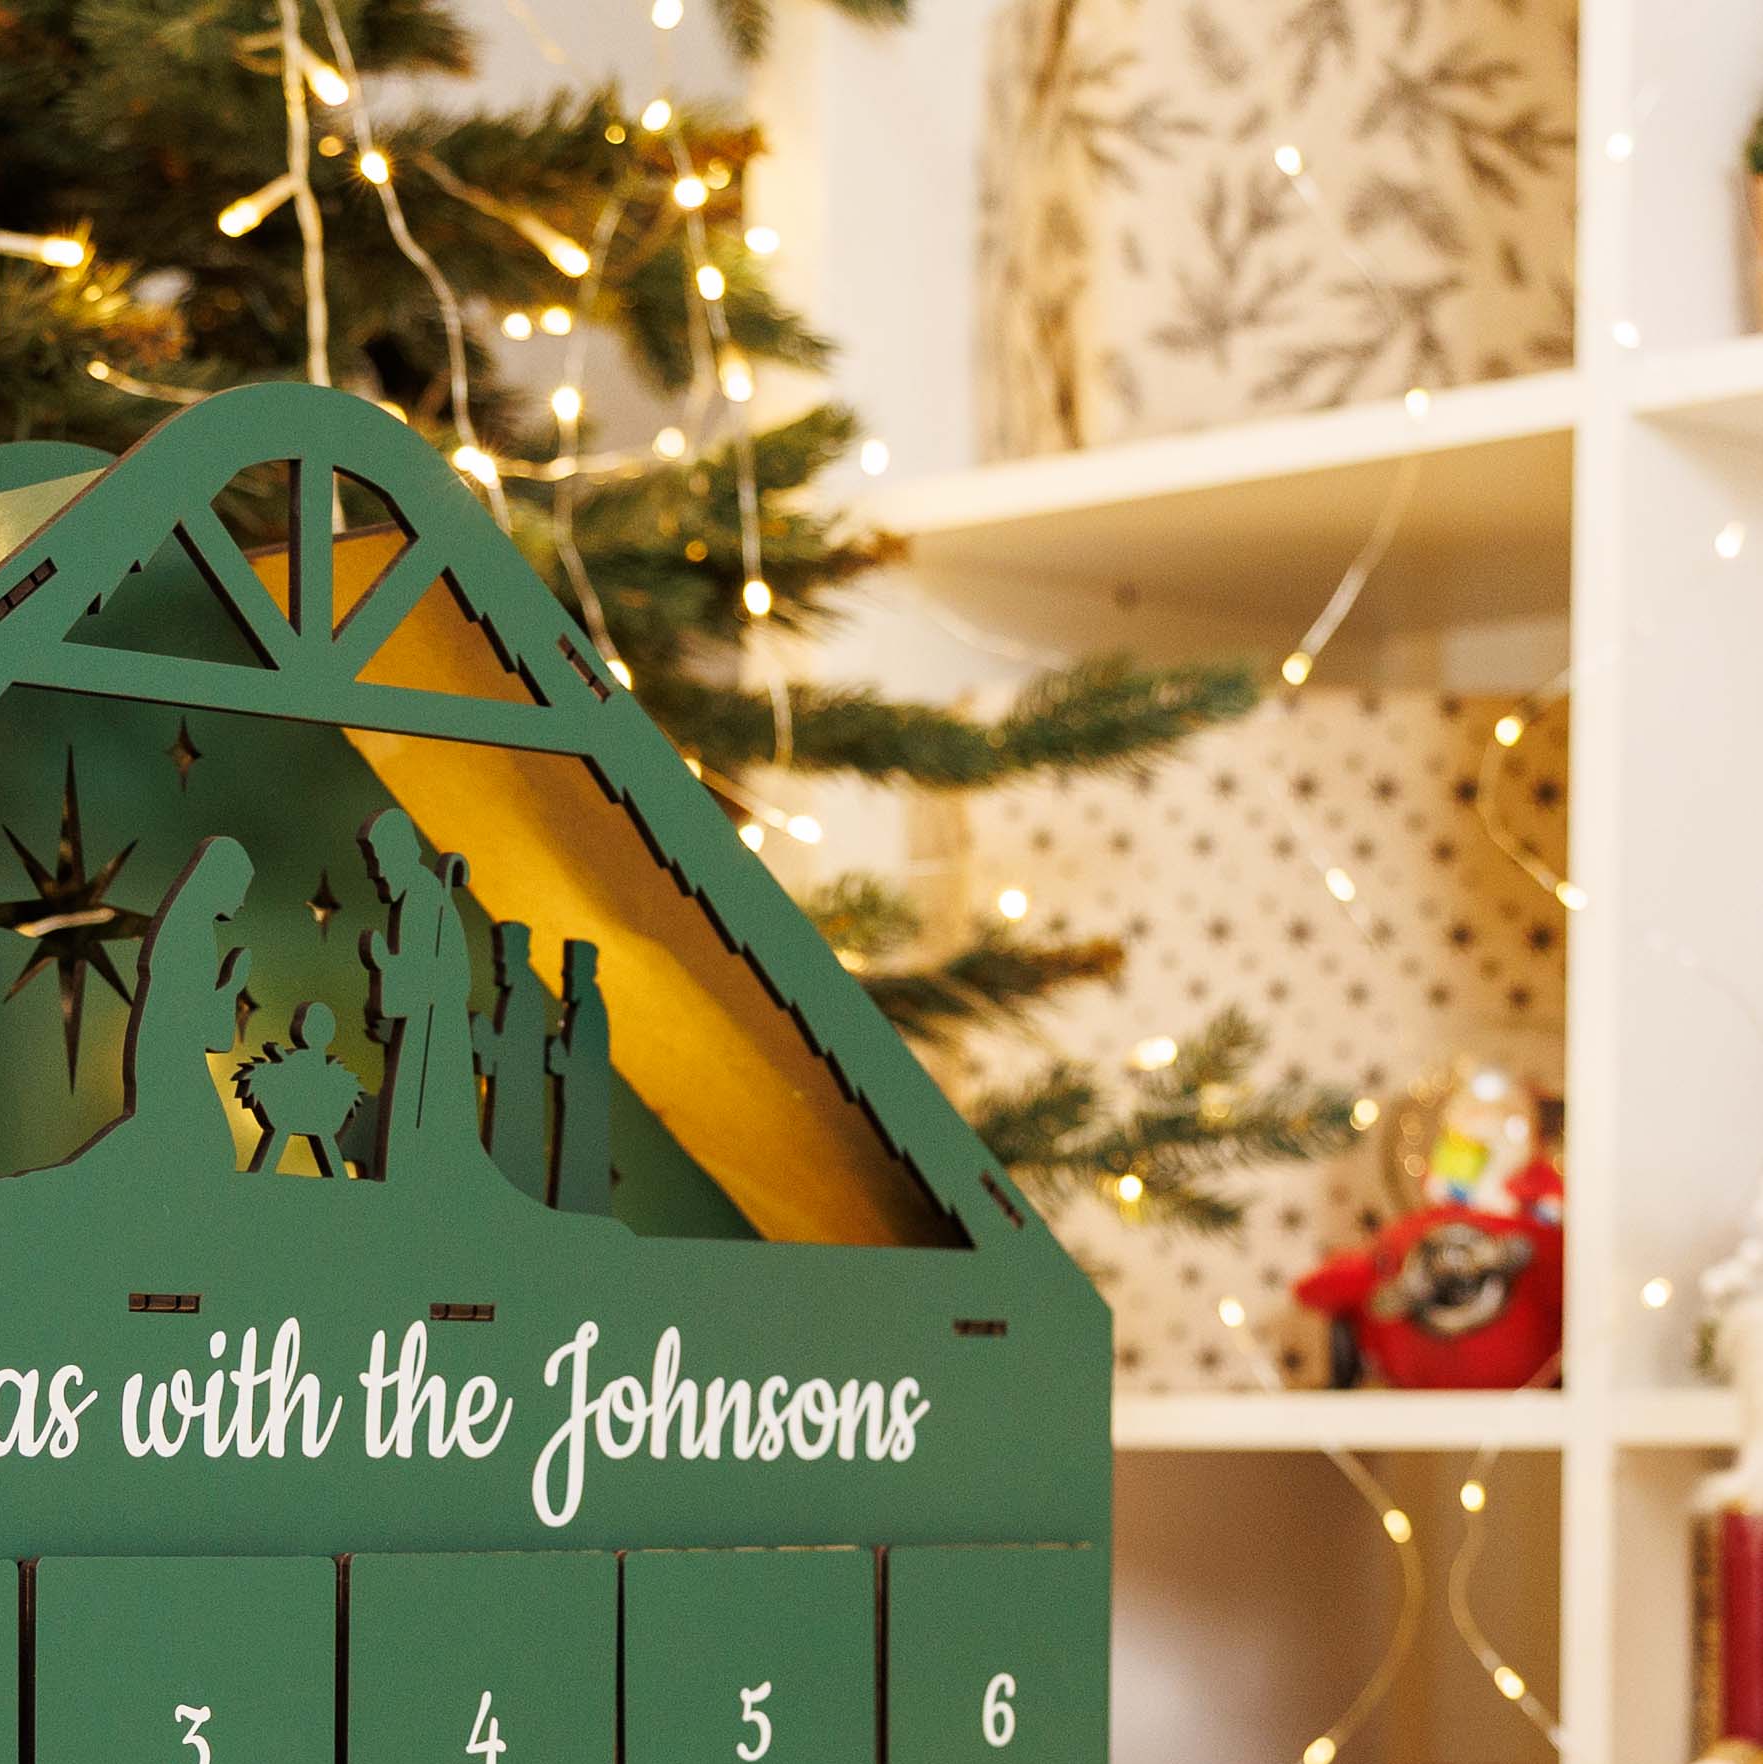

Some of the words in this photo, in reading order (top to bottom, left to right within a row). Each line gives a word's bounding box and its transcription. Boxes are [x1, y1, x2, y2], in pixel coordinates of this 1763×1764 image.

[121, 1317, 343, 1460] with
[358, 1319, 514, 1460] the
[531, 1320, 931, 1529] Johnsons
[736, 1681, 772, 1762] 5
[982, 1673, 1016, 1747] 6
